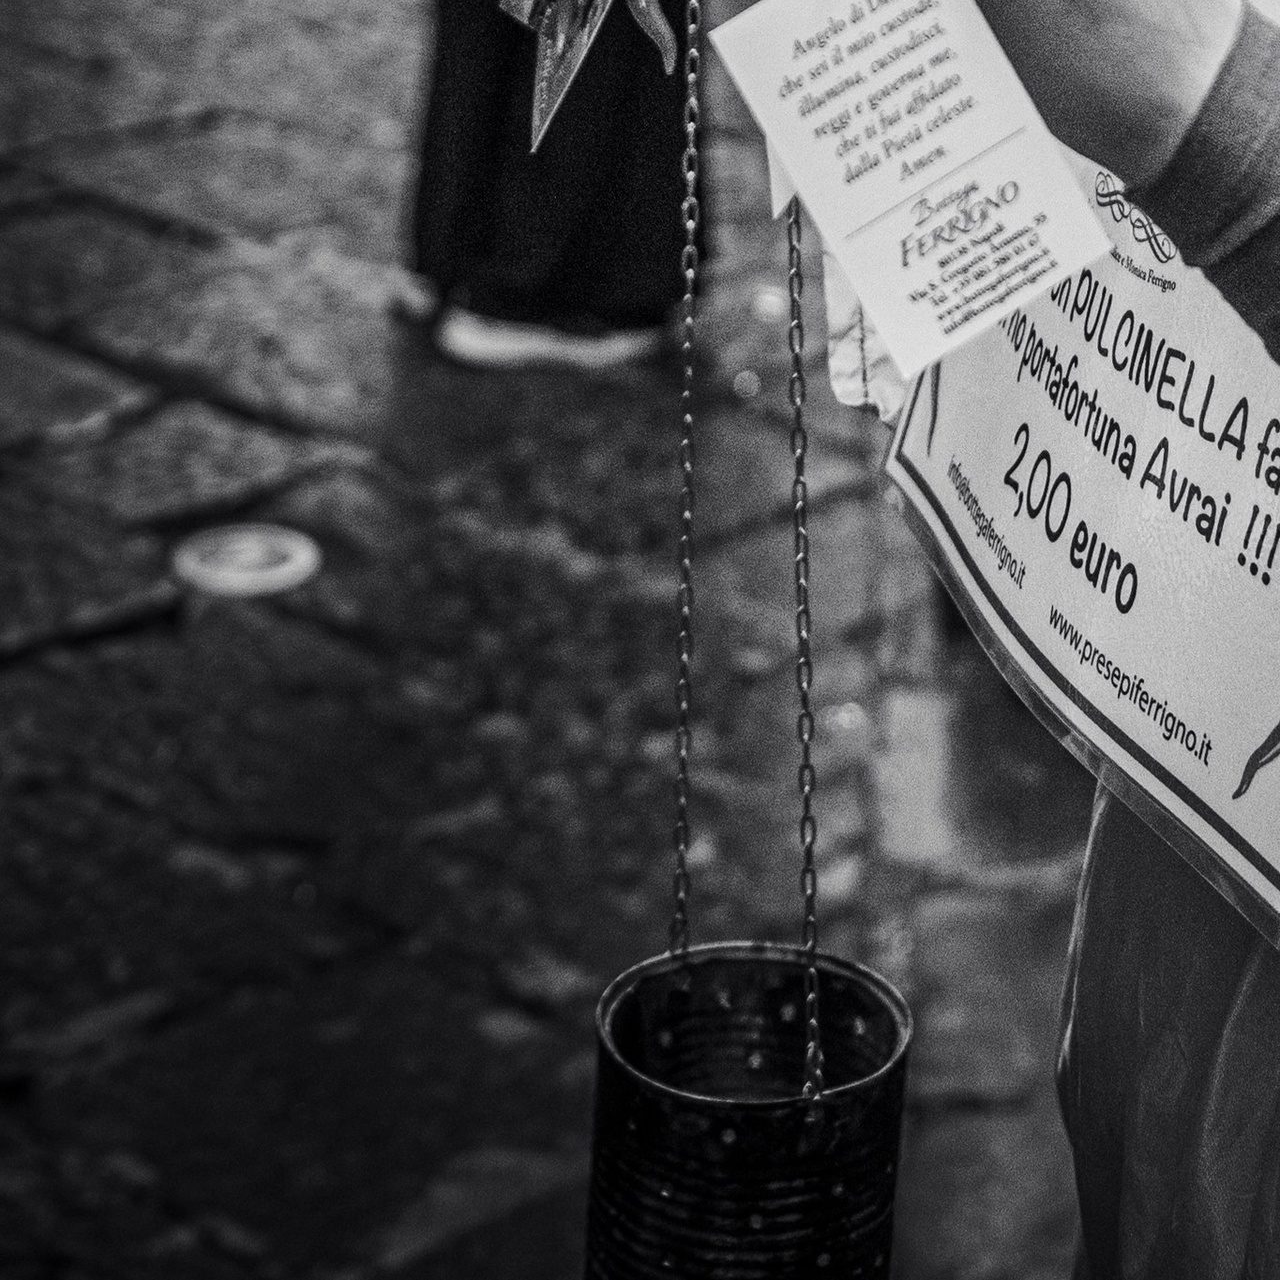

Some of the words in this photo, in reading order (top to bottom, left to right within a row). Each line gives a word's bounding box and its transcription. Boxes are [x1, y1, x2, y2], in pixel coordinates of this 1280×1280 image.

[900, 180, 1019, 268] FERRIGNO
[1147, 268, 1177, 293] Ferrigno
[1017, 322, 1136, 481] portafortuna
[1140, 436, 1233, 547] Avrai
[1069, 267, 1250, 461] PULCINELLA
[946, 453, 1027, 590] info@bottegaferrigno.it
[1003, 422, 1072, 543] 2,00
[1069, 519, 1138, 615] euro
[1049, 604, 1213, 767] www.presepiferrigno.it
